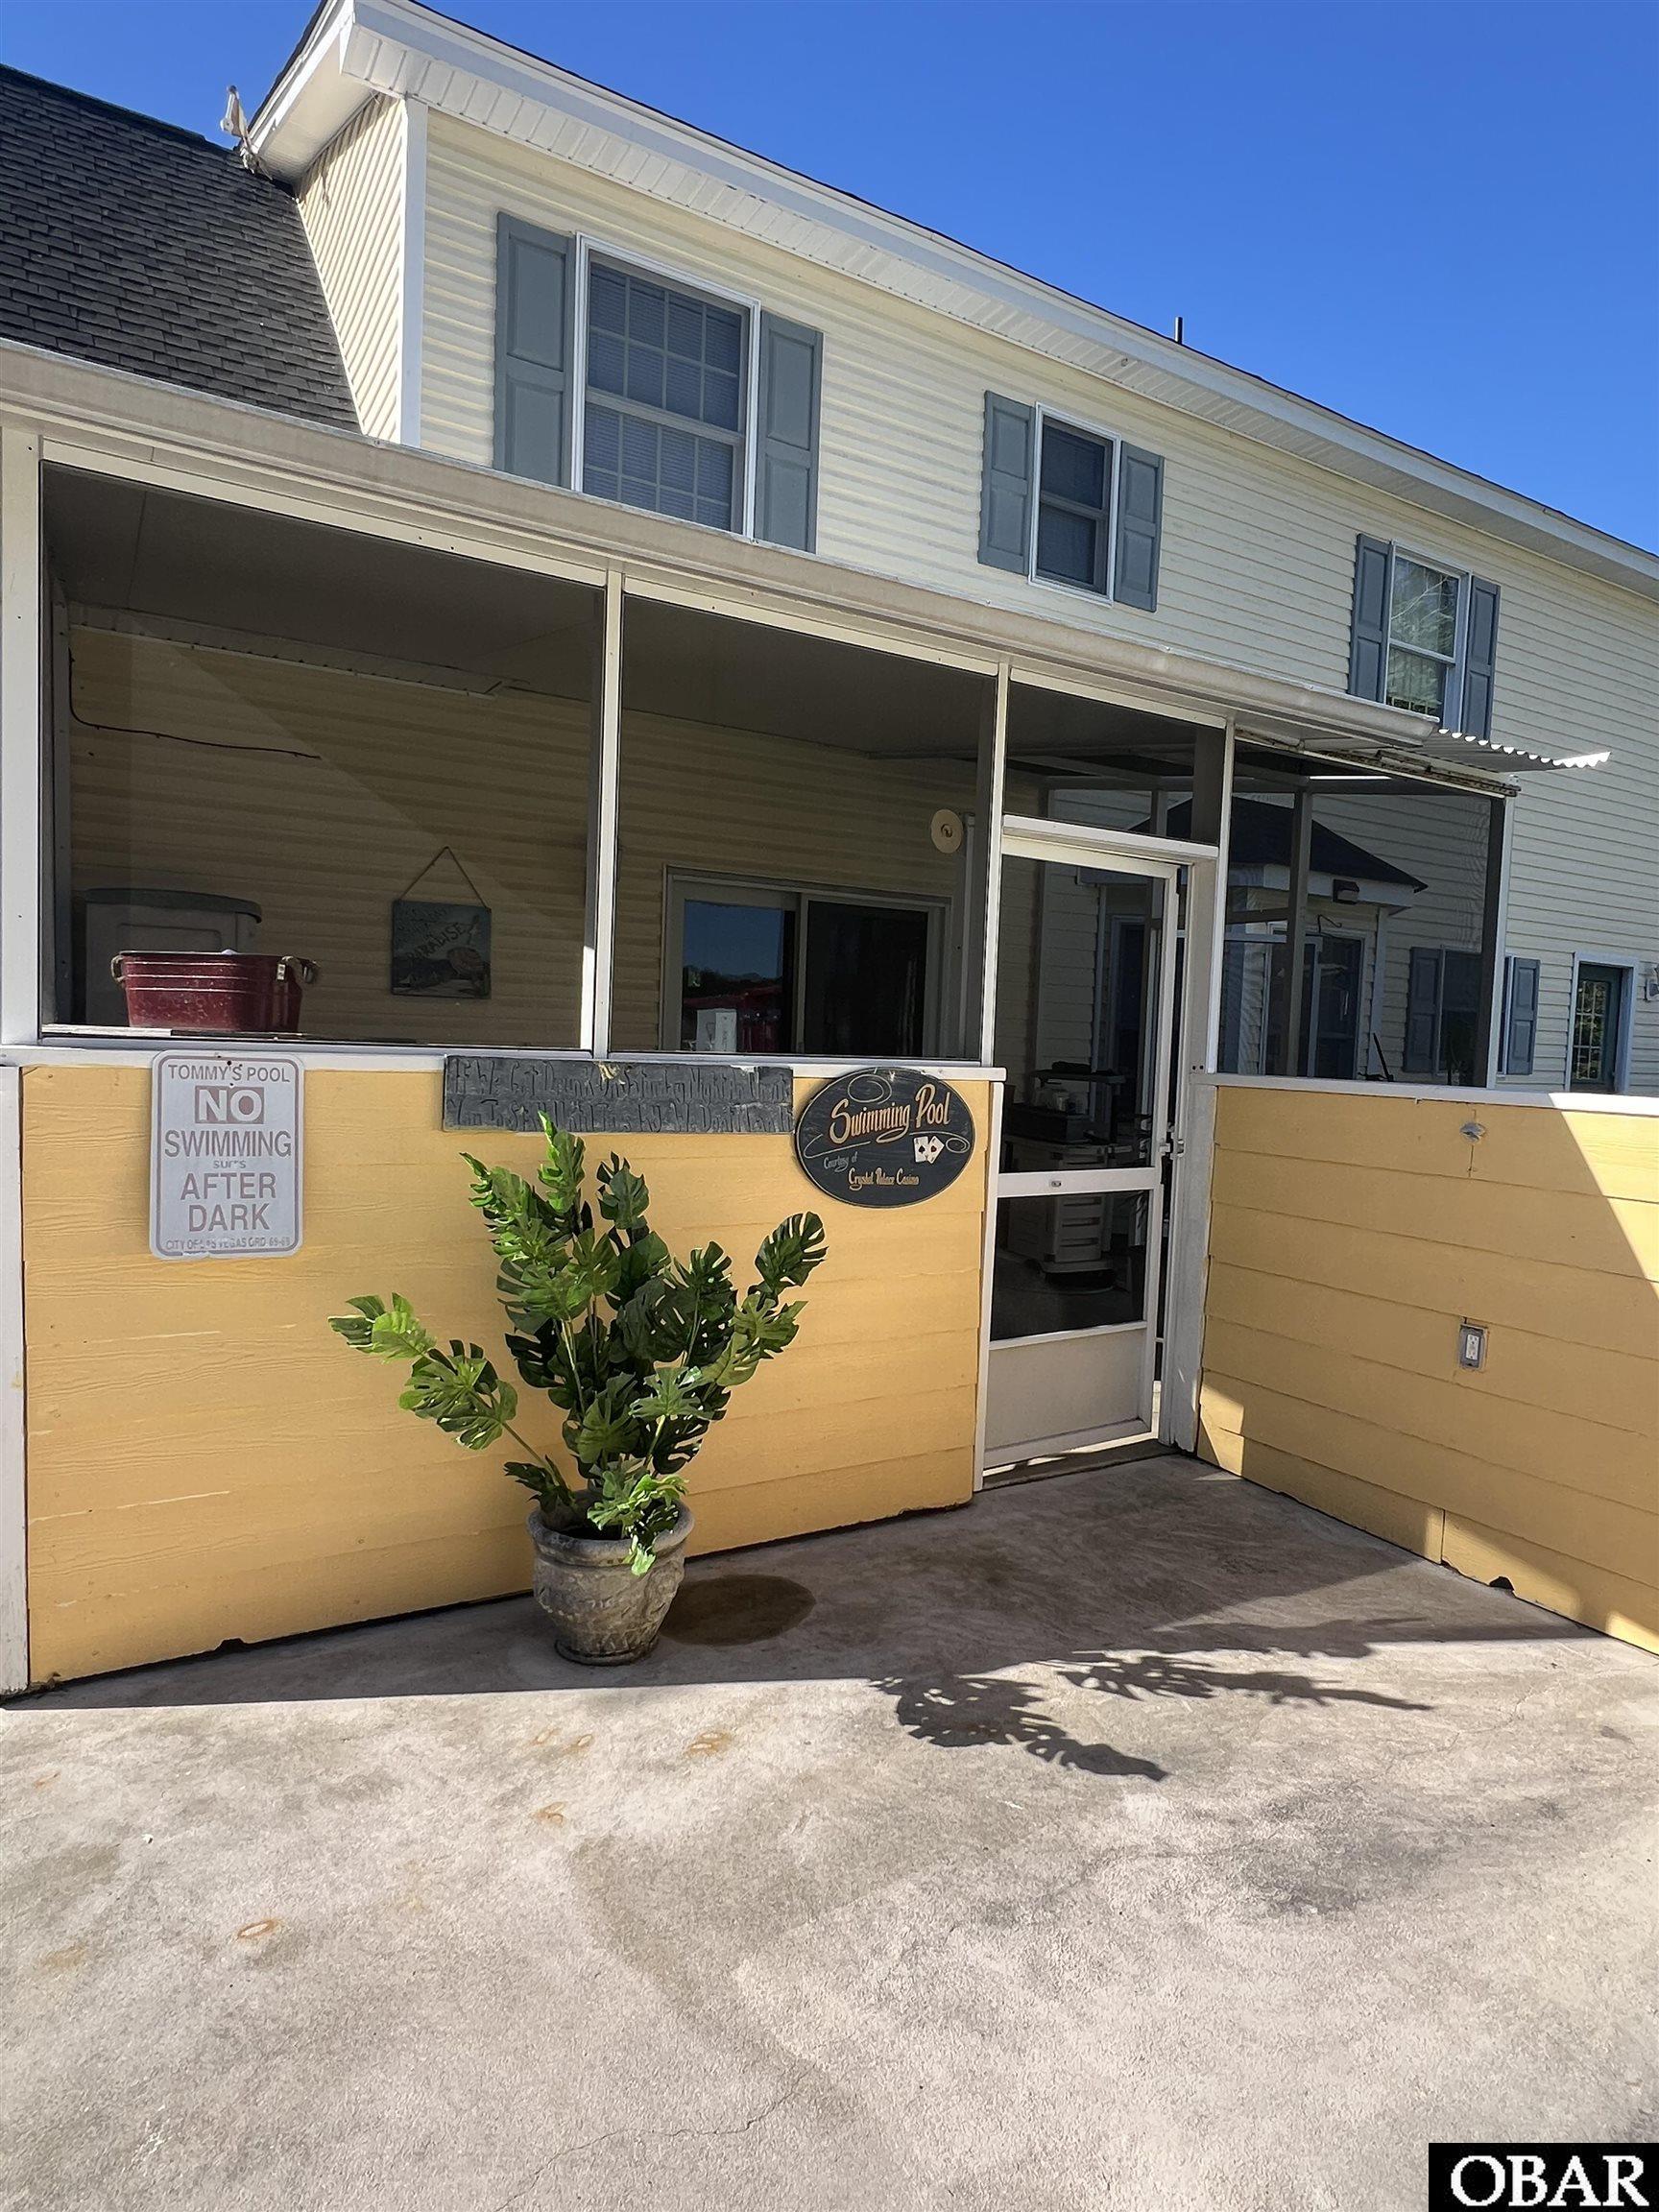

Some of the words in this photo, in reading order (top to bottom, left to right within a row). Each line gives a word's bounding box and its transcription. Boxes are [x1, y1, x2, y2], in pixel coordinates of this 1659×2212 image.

[167, 1064, 243, 1081] TOMMY'S
[246, 1067, 291, 1083] POOL
[198, 1089, 263, 1122] NO
[829, 1097, 911, 1144] Swimming
[915, 1083, 951, 1129] Pool
[164, 1130, 292, 1158] SWIMMING
[823, 1155, 850, 1173] Courtesy
[851, 1150, 859, 1164] of
[180, 1172, 276, 1200] AFTER
[848, 1166, 875, 1191] Crystal
[875, 1166, 896, 1186] Palace
[896, 1167, 920, 1186] Casino
[188, 1203, 271, 1233] DARK
